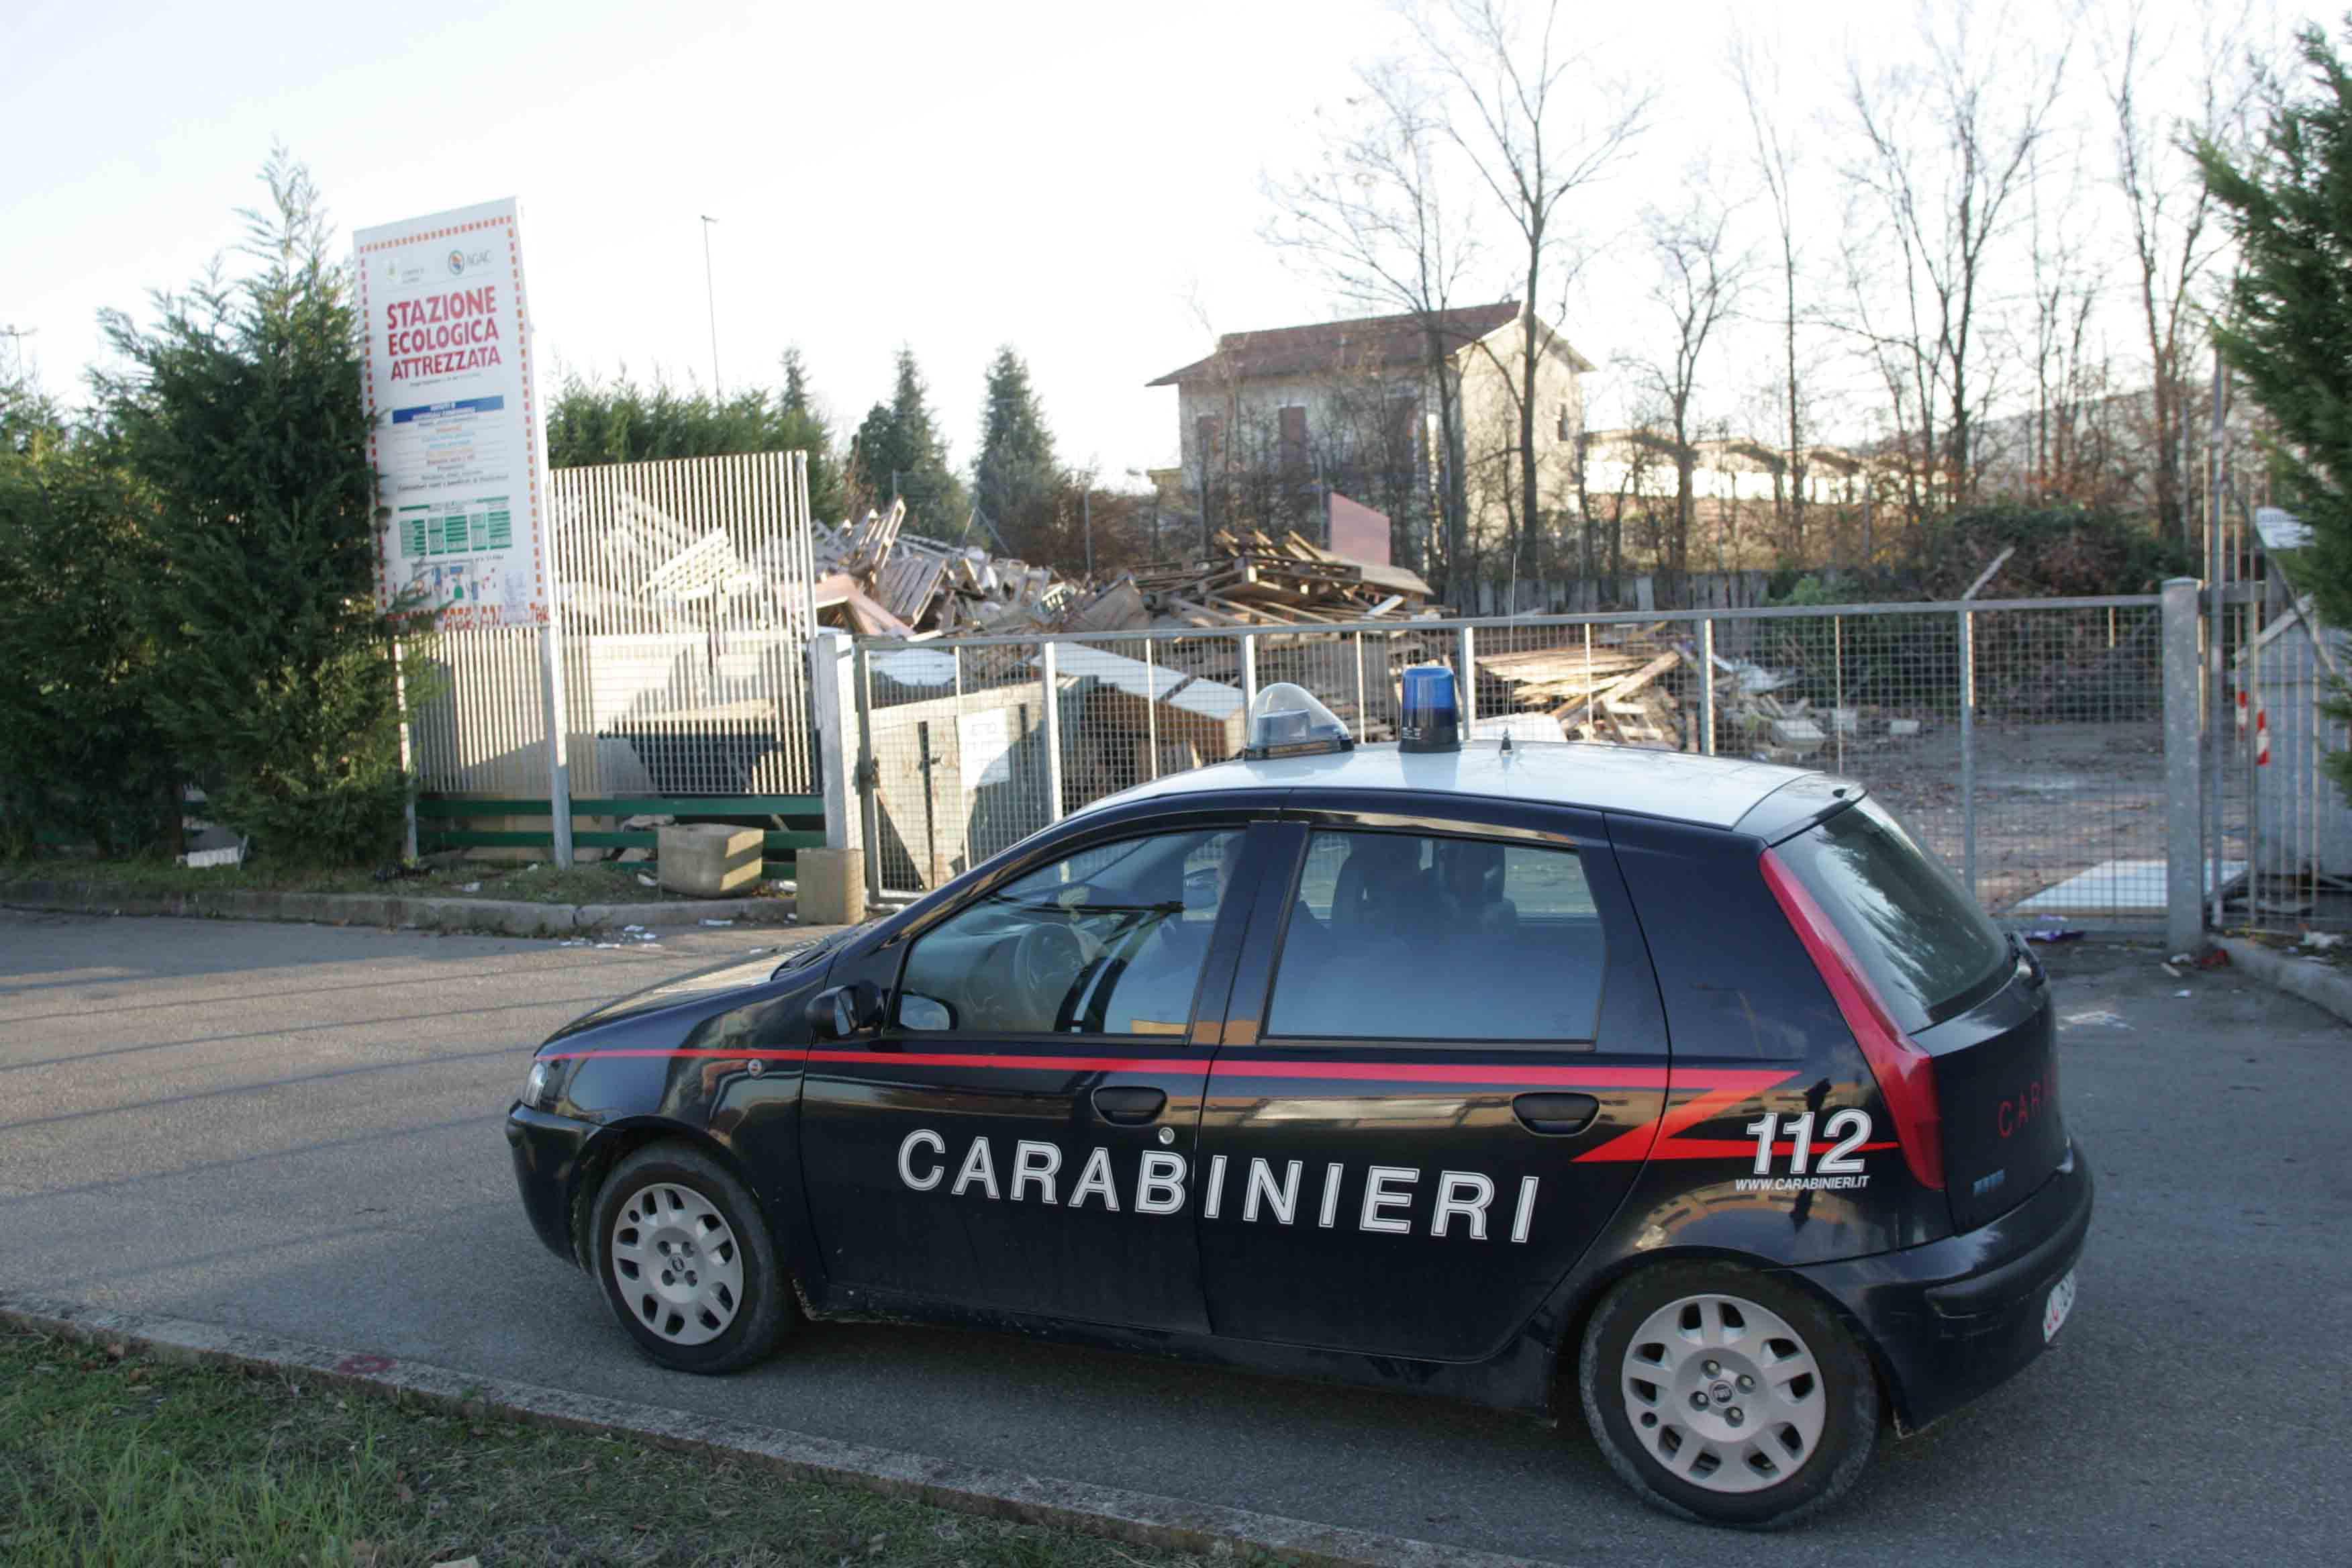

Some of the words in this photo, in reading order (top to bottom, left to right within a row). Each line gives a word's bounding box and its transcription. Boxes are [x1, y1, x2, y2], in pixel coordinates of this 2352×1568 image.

[387, 286, 497, 330] STAZIONE
[387, 317, 499, 357] ECOLOGICA
[391, 346, 502, 382] ATTREZZATA
[1747, 1108, 1872, 1175] 112
[897, 1128, 1540, 1244] CARABINIERI
[1735, 1175, 1871, 1191] WWW.CARABINIERI.IT
